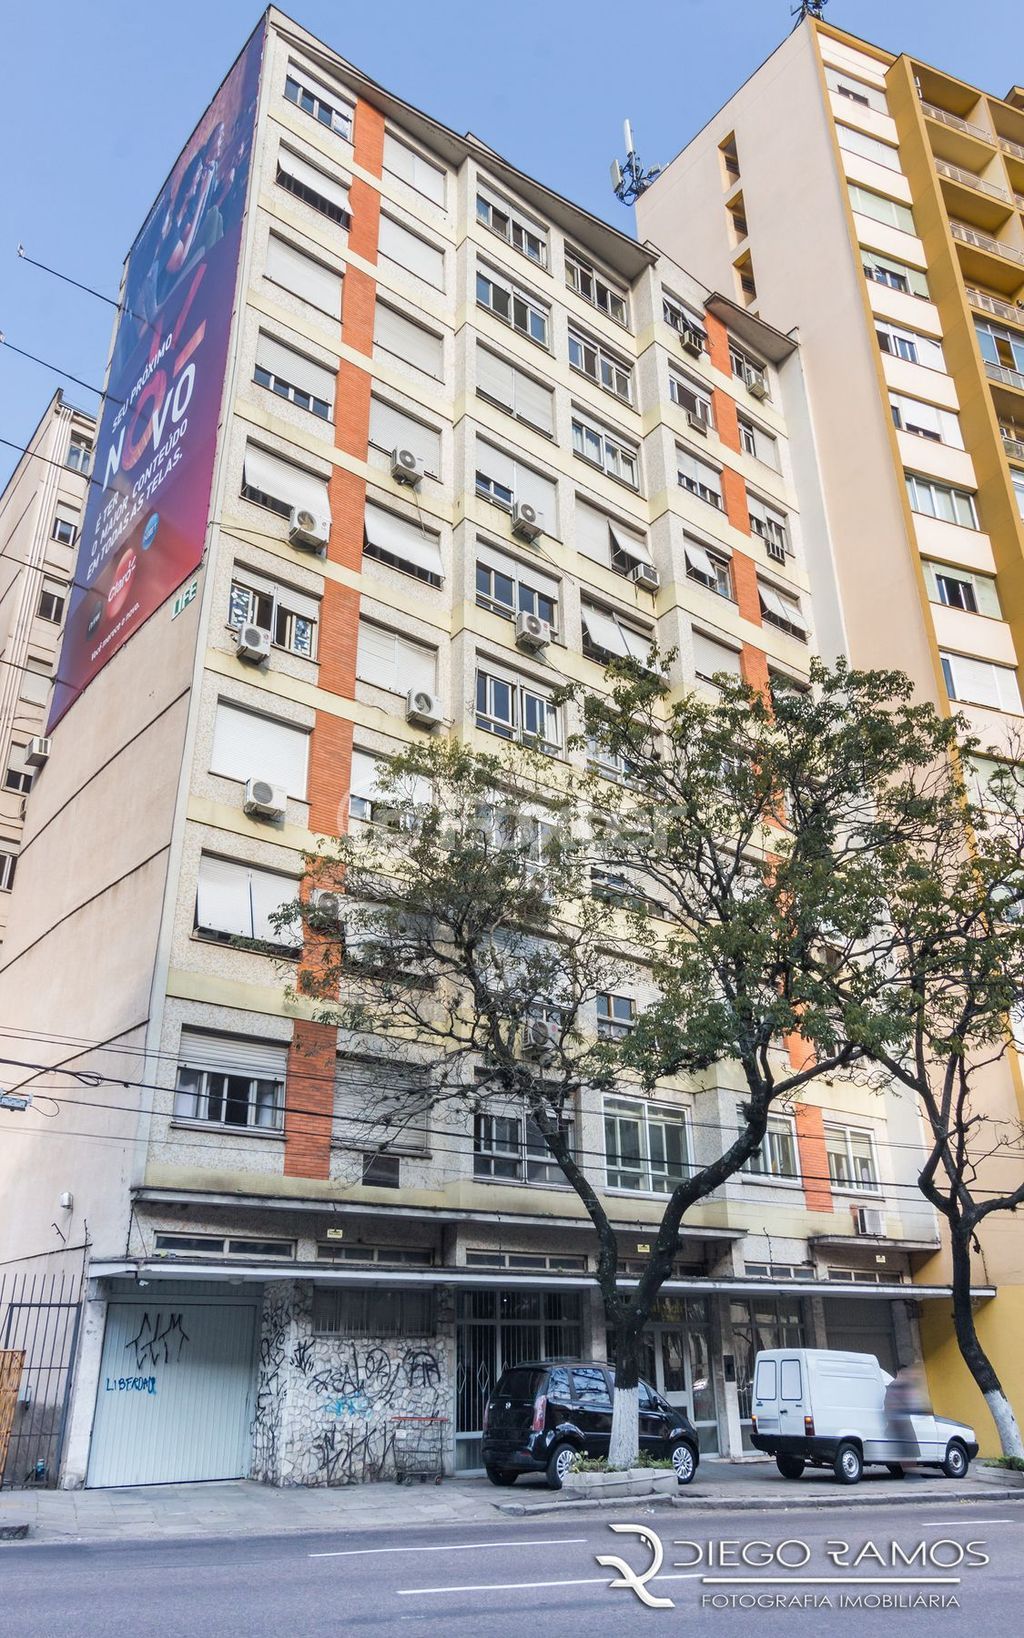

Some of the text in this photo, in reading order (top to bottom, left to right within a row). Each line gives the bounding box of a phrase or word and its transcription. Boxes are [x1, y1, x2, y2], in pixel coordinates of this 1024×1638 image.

[102, 362, 196, 493] NOVO
[112, 333, 173, 433] SEU PRÓXIMO
[86, 446, 183, 582] EM TODAS AS TELAS.
[100, 495, 129, 545] MAIOR
[132, 418, 188, 499] CONTEÚDO
[103, 491, 120, 523] TER
